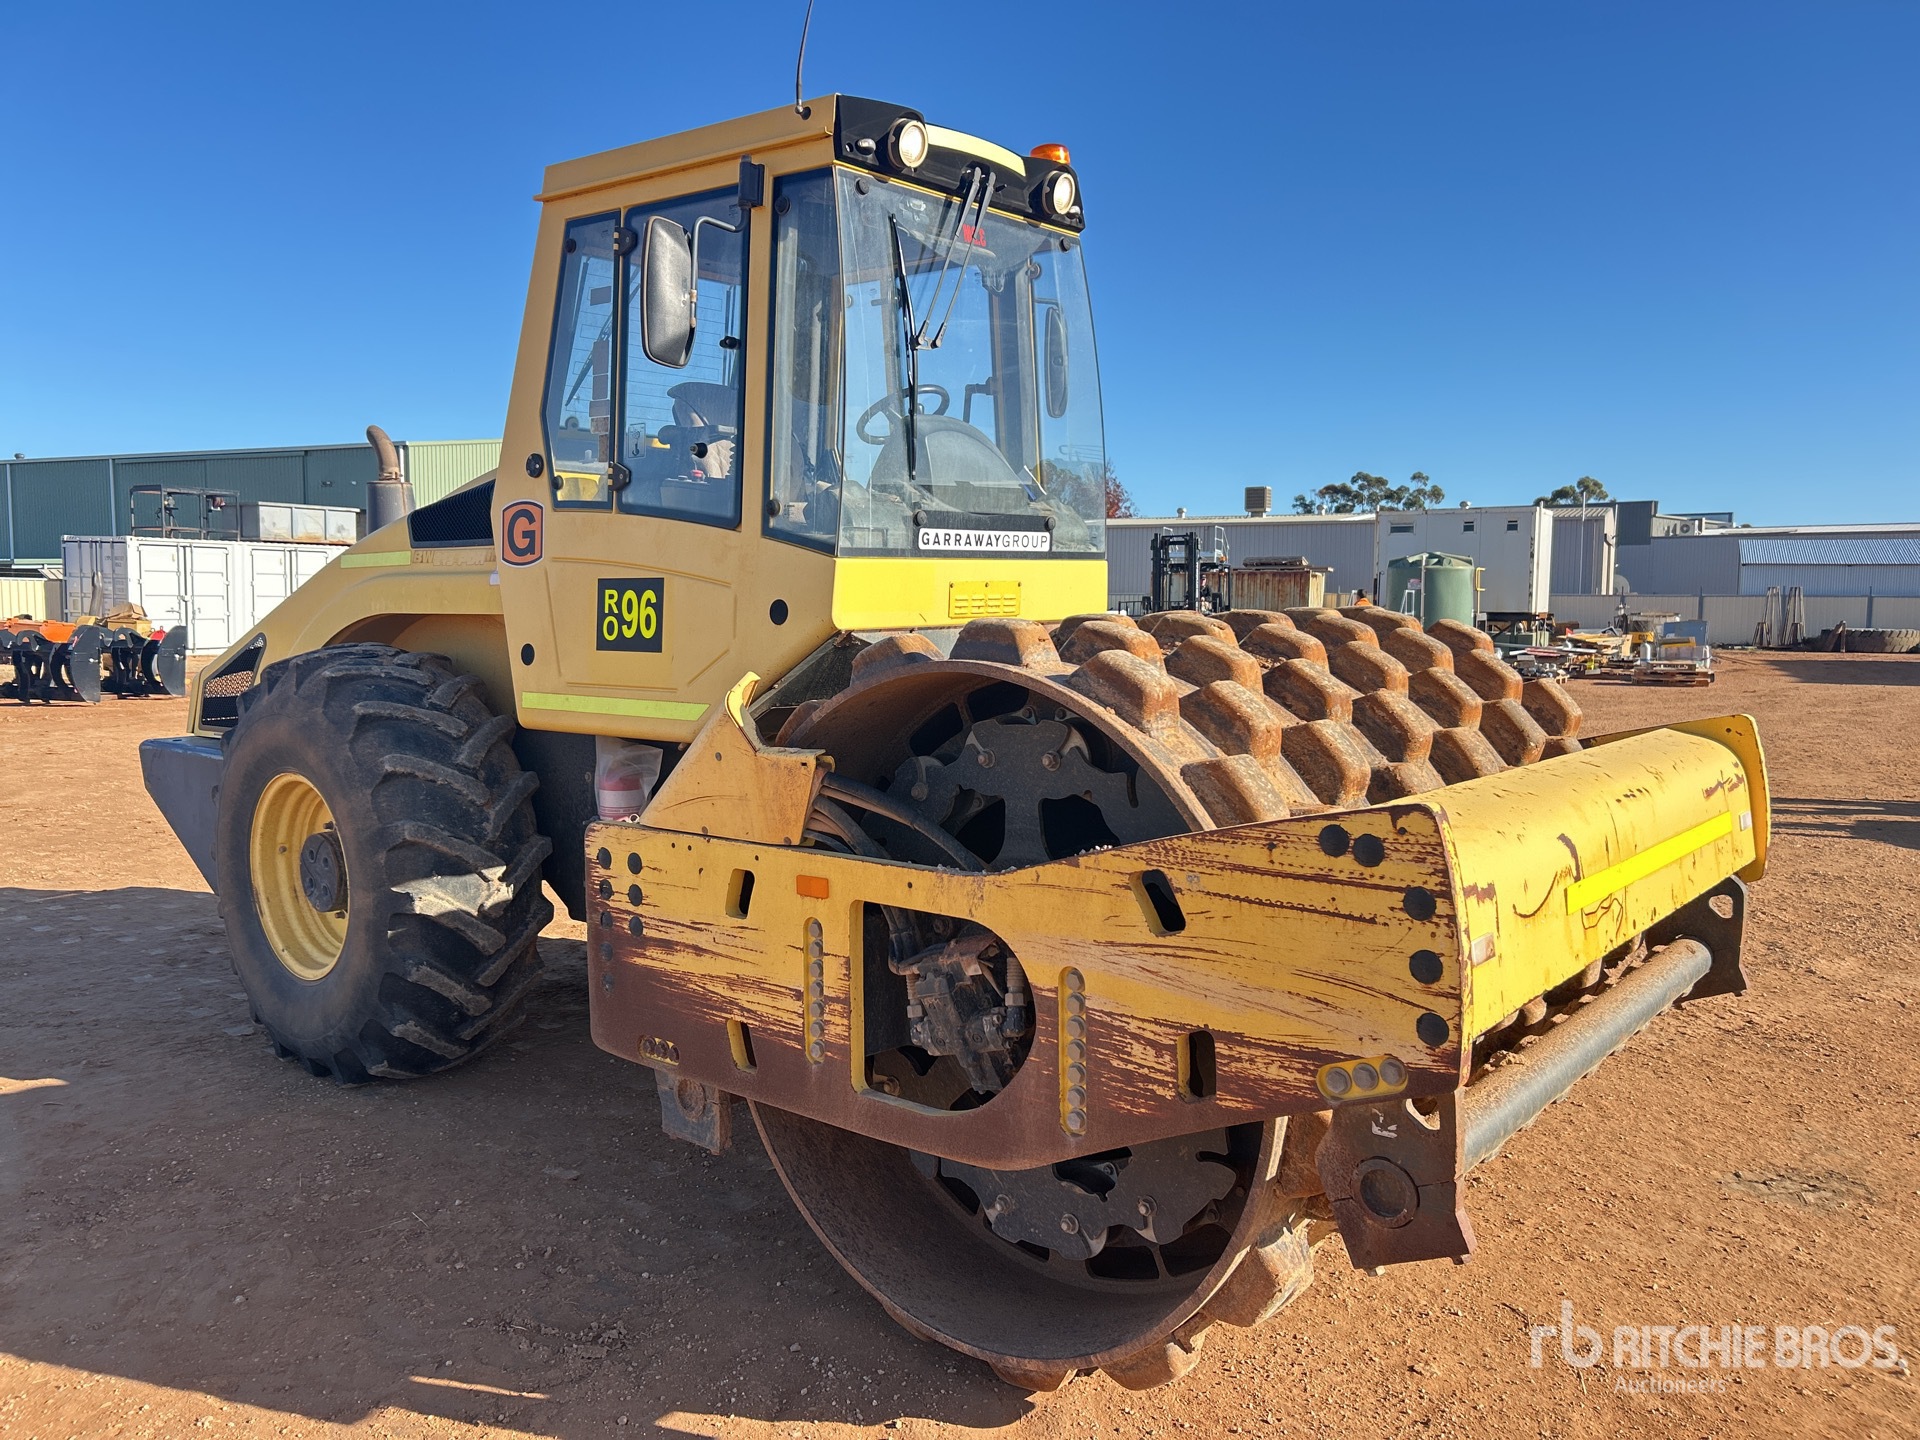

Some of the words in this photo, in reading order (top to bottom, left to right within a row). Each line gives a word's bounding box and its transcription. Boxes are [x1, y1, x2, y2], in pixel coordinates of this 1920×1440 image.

[507, 508, 536, 557] G
[921, 532, 1048, 548] GARRAWAYGROUP
[621, 590, 657, 639] 96
